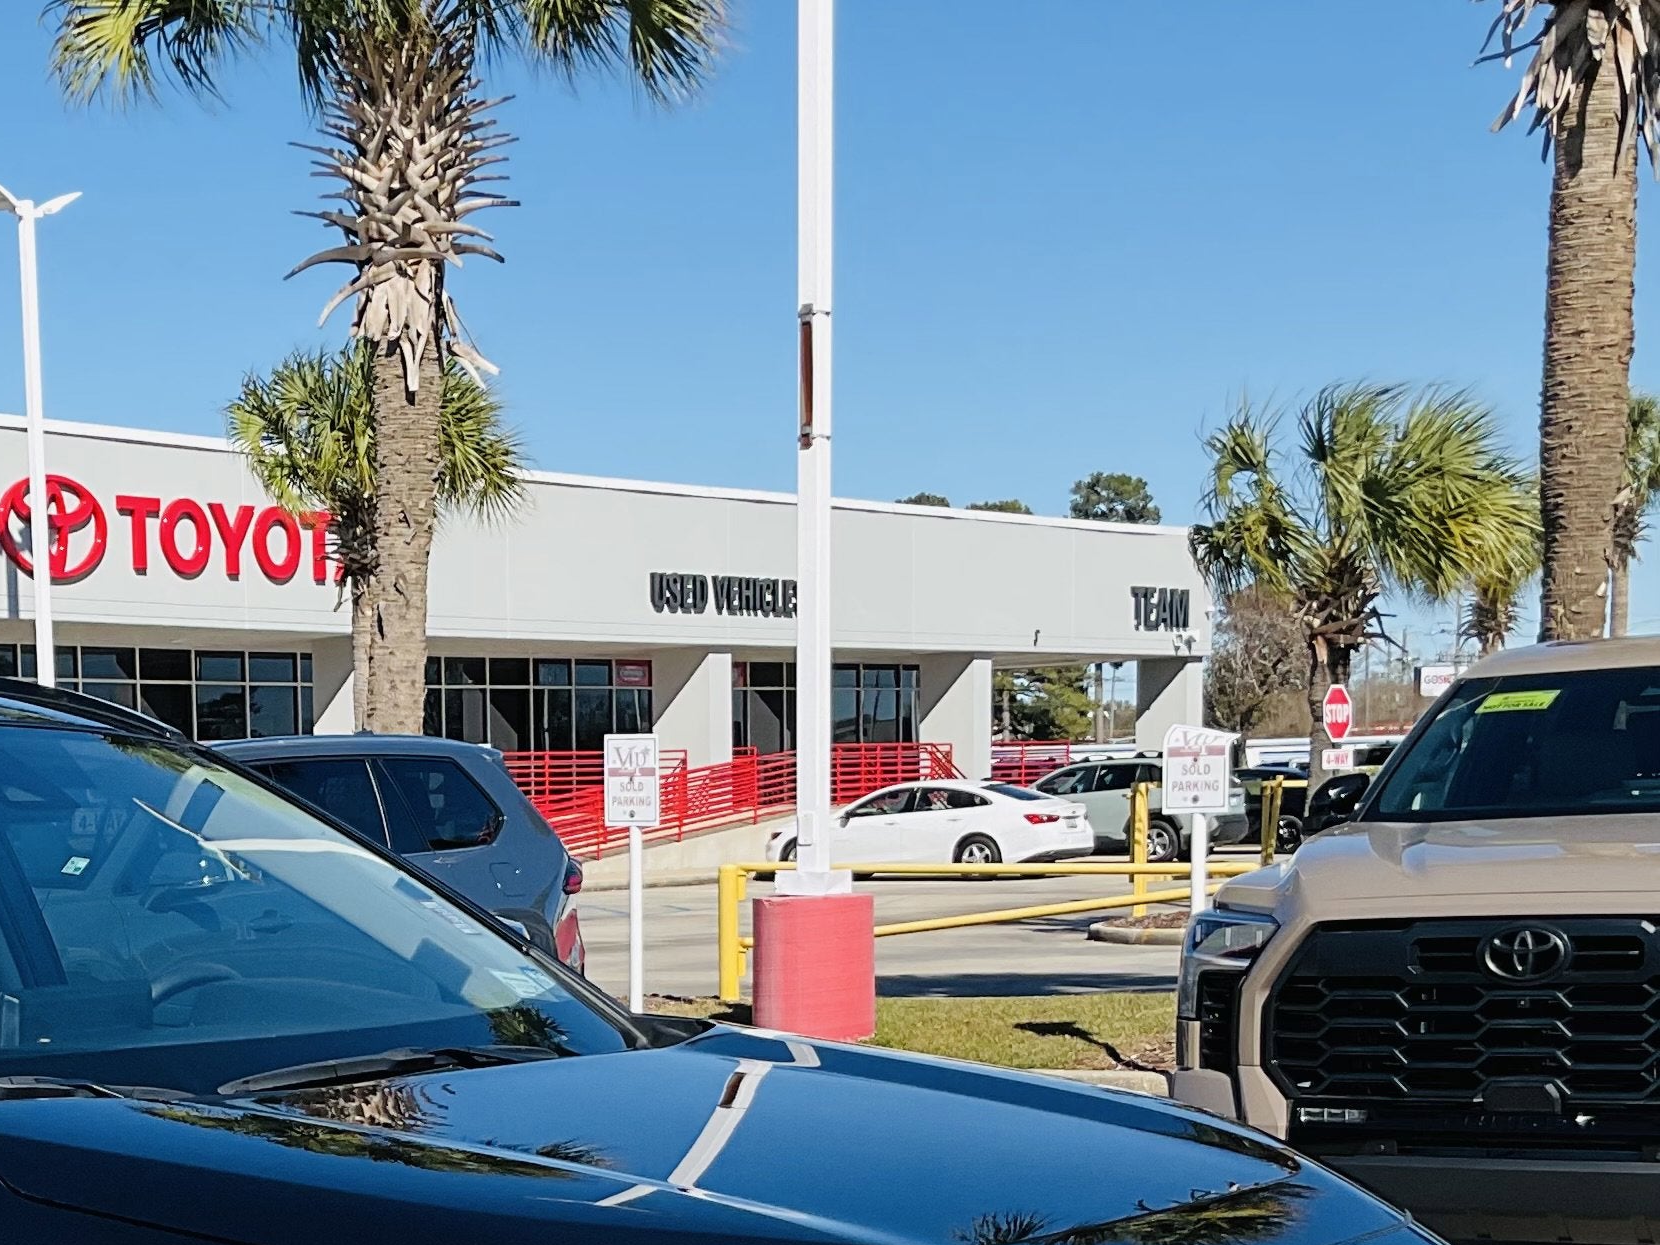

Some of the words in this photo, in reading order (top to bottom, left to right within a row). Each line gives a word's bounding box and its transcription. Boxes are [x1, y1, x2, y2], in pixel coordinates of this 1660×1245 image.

[116, 494, 345, 586] TOYOT
[649, 572, 709, 615] USED
[711, 575, 798, 618] VEHICLE
[1130, 585, 1190, 632] TEAM
[1325, 703, 1349, 723] STOP
[1326, 752, 1349, 765] 4-WAY
[1181, 763, 1211, 776] SOLD
[620, 781, 644, 793] SOLD
[1171, 780, 1220, 792] PARKING
[611, 796, 652, 807] PARKING
